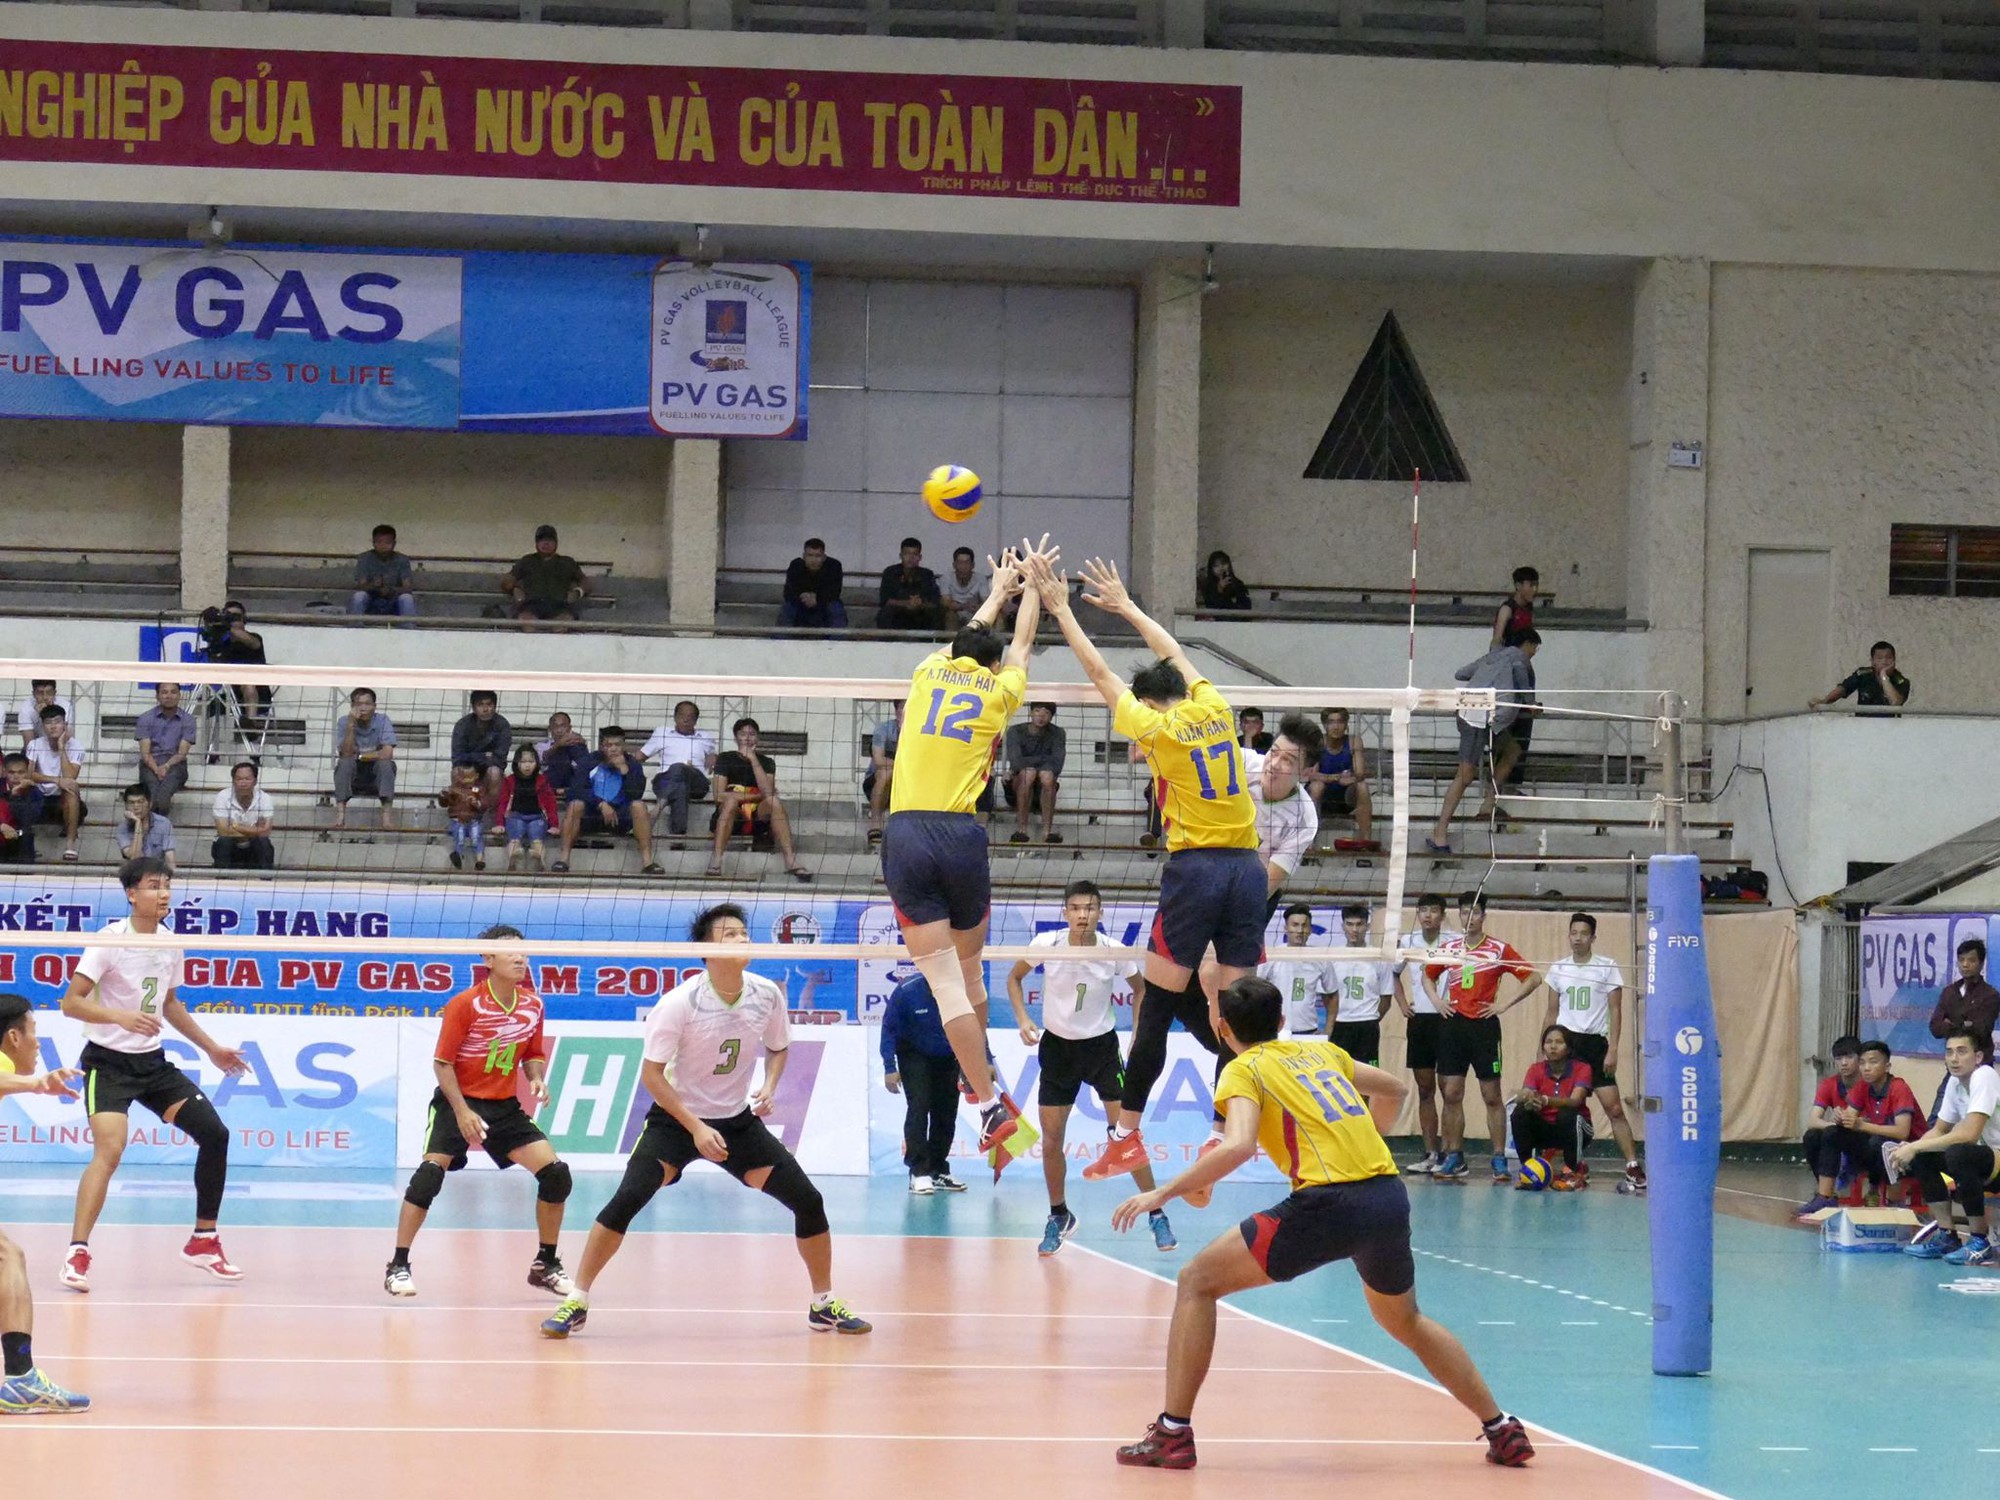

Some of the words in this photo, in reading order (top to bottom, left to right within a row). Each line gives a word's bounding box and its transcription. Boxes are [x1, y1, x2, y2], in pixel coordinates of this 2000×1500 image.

[209, 62, 316, 147] CỦA
[341, 70, 449, 153] NHÀ
[475, 76, 625, 159] NƯỚC
[648, 81, 716, 164] VÀ
[739, 82, 843, 168] CỦA
[865, 89, 1005, 175] TOÀN
[2, 261, 141, 336] PV
[175, 266, 404, 344] GAS
[664, 301, 682, 326] GAS
[681, 279, 765, 302] VOLLEYBALL
[765, 299, 790, 349] LEAGUE
[154, 359, 272, 382] VALUES
[283, 363, 320, 384] TO
[330, 366, 395, 386] LIFE
[662, 382, 708, 406] PV
[716, 383, 788, 408] GAS
[659, 411, 707, 420] FUELLING
[710, 412, 747, 421] VALUES
[920, 688, 984, 744] 12
[1190, 740, 1240, 800] 17
[160, 897, 239, 935] ẾP
[184, 958, 262, 987] GIA
[279, 960, 343, 990] PV
[359, 962, 453, 991] GAS
[1461, 965, 1476, 990] 6
[1862, 933, 1889, 989] PV
[1893, 932, 1937, 989] GAS
[140, 976, 158, 1014] 2
[1075, 982, 1087, 1013] 1
[1291, 977, 1306, 1002] 8
[1342, 976, 1365, 1001] 15
[1566, 985, 1591, 1011] 10
[483, 1039, 517, 1077] 14
[713, 1038, 741, 1075] 3
[1295, 1070, 1367, 1124] 10
[1682, 1066, 1698, 1141] Senoh
[239, 1129, 276, 1147] TO
[286, 1131, 351, 1150] LIFE
